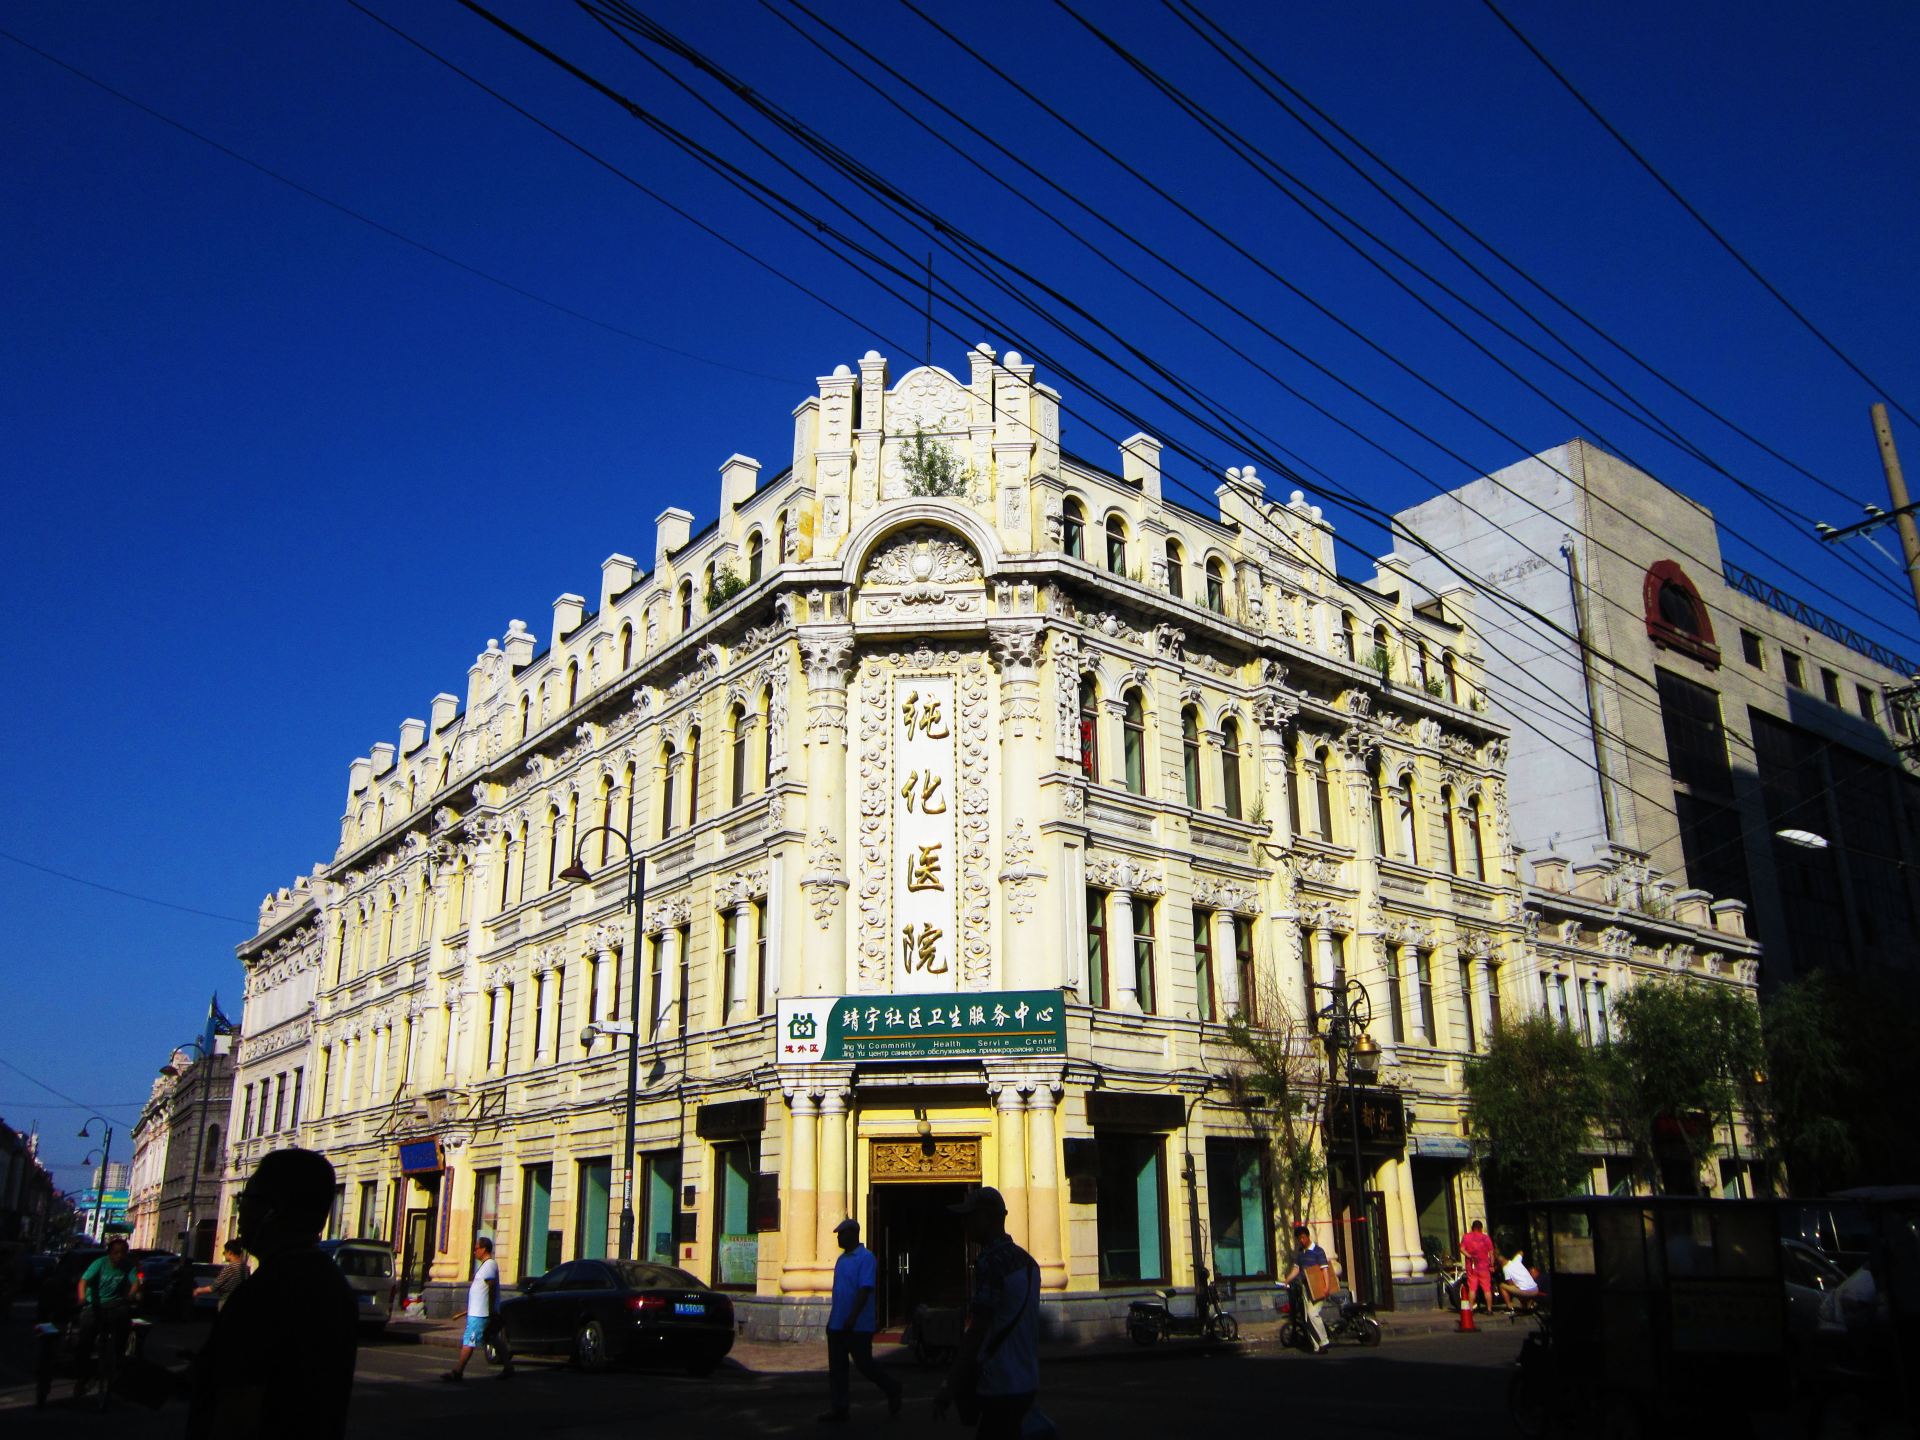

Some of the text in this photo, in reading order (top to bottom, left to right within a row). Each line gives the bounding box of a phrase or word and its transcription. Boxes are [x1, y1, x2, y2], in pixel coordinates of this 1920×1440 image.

[902, 690, 950, 975] 纯化医院
[842, 1001, 1054, 1032] 靖宇社区卫生服务中心
[842, 1043, 854, 1051] Jing
[933, 1040, 961, 1048] Health
[1025, 1038, 1057, 1046] Center
[842, 1051, 854, 1059] Jing
